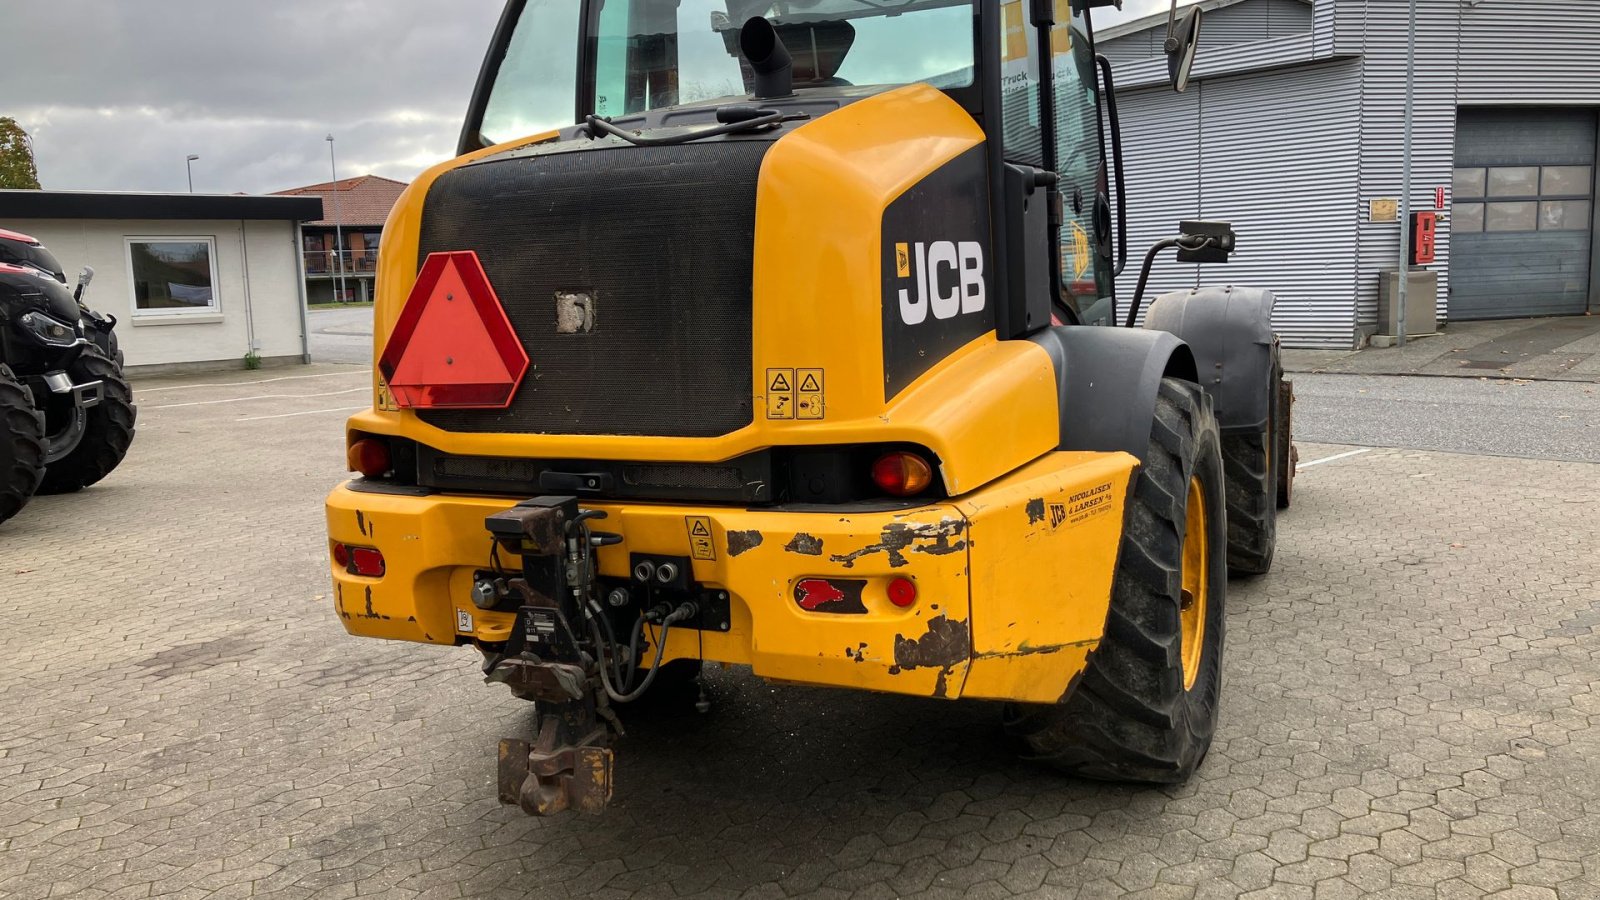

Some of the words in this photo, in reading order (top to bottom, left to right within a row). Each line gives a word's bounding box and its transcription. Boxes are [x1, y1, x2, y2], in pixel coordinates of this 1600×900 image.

[1002, 71, 1028, 85] Truck
[899, 241, 985, 325] JCB
[1069, 482, 1112, 504] NICOLAISEN
[1075, 496, 1104, 512] LARSEN
[1050, 504, 1066, 529] JCB
